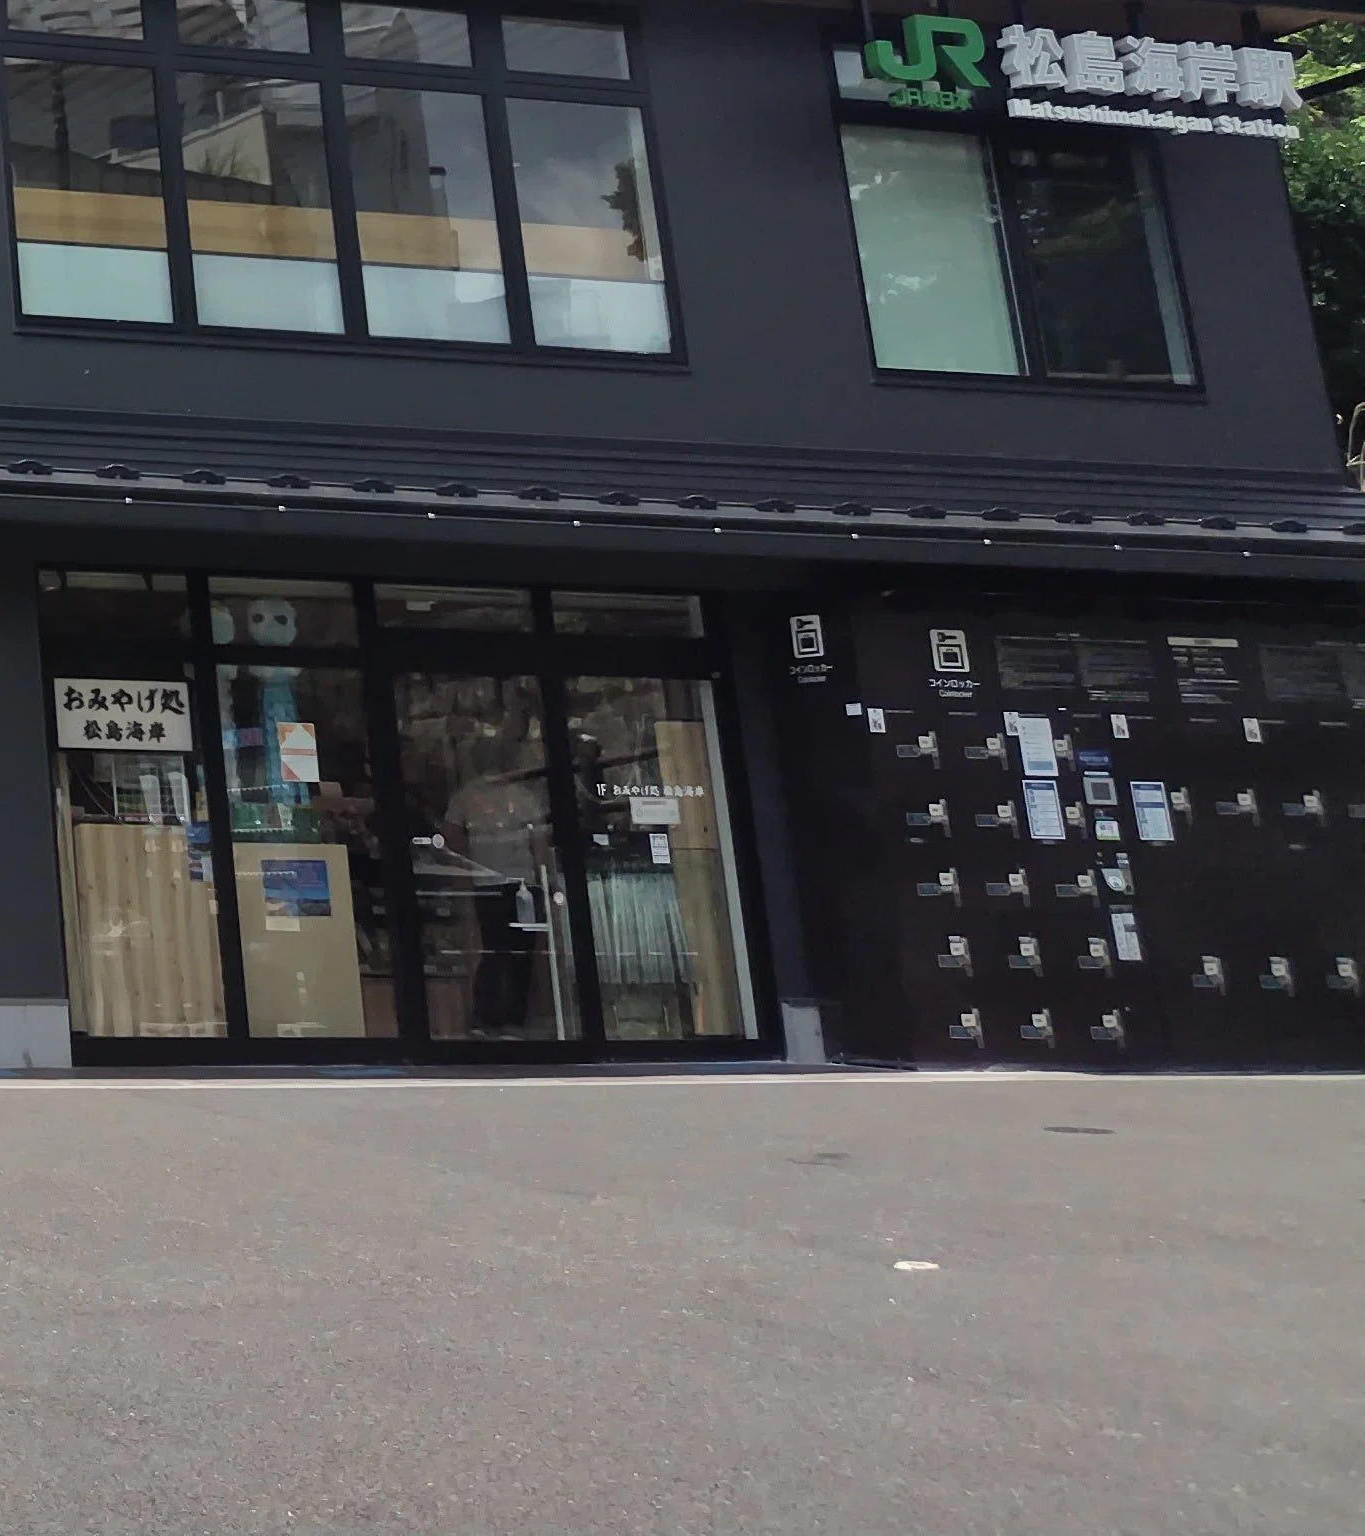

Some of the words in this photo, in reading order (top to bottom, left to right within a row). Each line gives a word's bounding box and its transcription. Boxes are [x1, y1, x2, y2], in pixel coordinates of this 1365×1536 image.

[865, 13, 990, 88] JR
[997, 24, 1303, 111] 松島海岸駅
[888, 87, 974, 111] JR東日本
[1007, 98, 1215, 135] Matsushimakaigan
[1216, 114, 1300, 139] Station
[928, 678, 980, 688] コインロッカー
[64, 686, 185, 715] おみやげ処
[83, 719, 167, 743] 松島海岸
